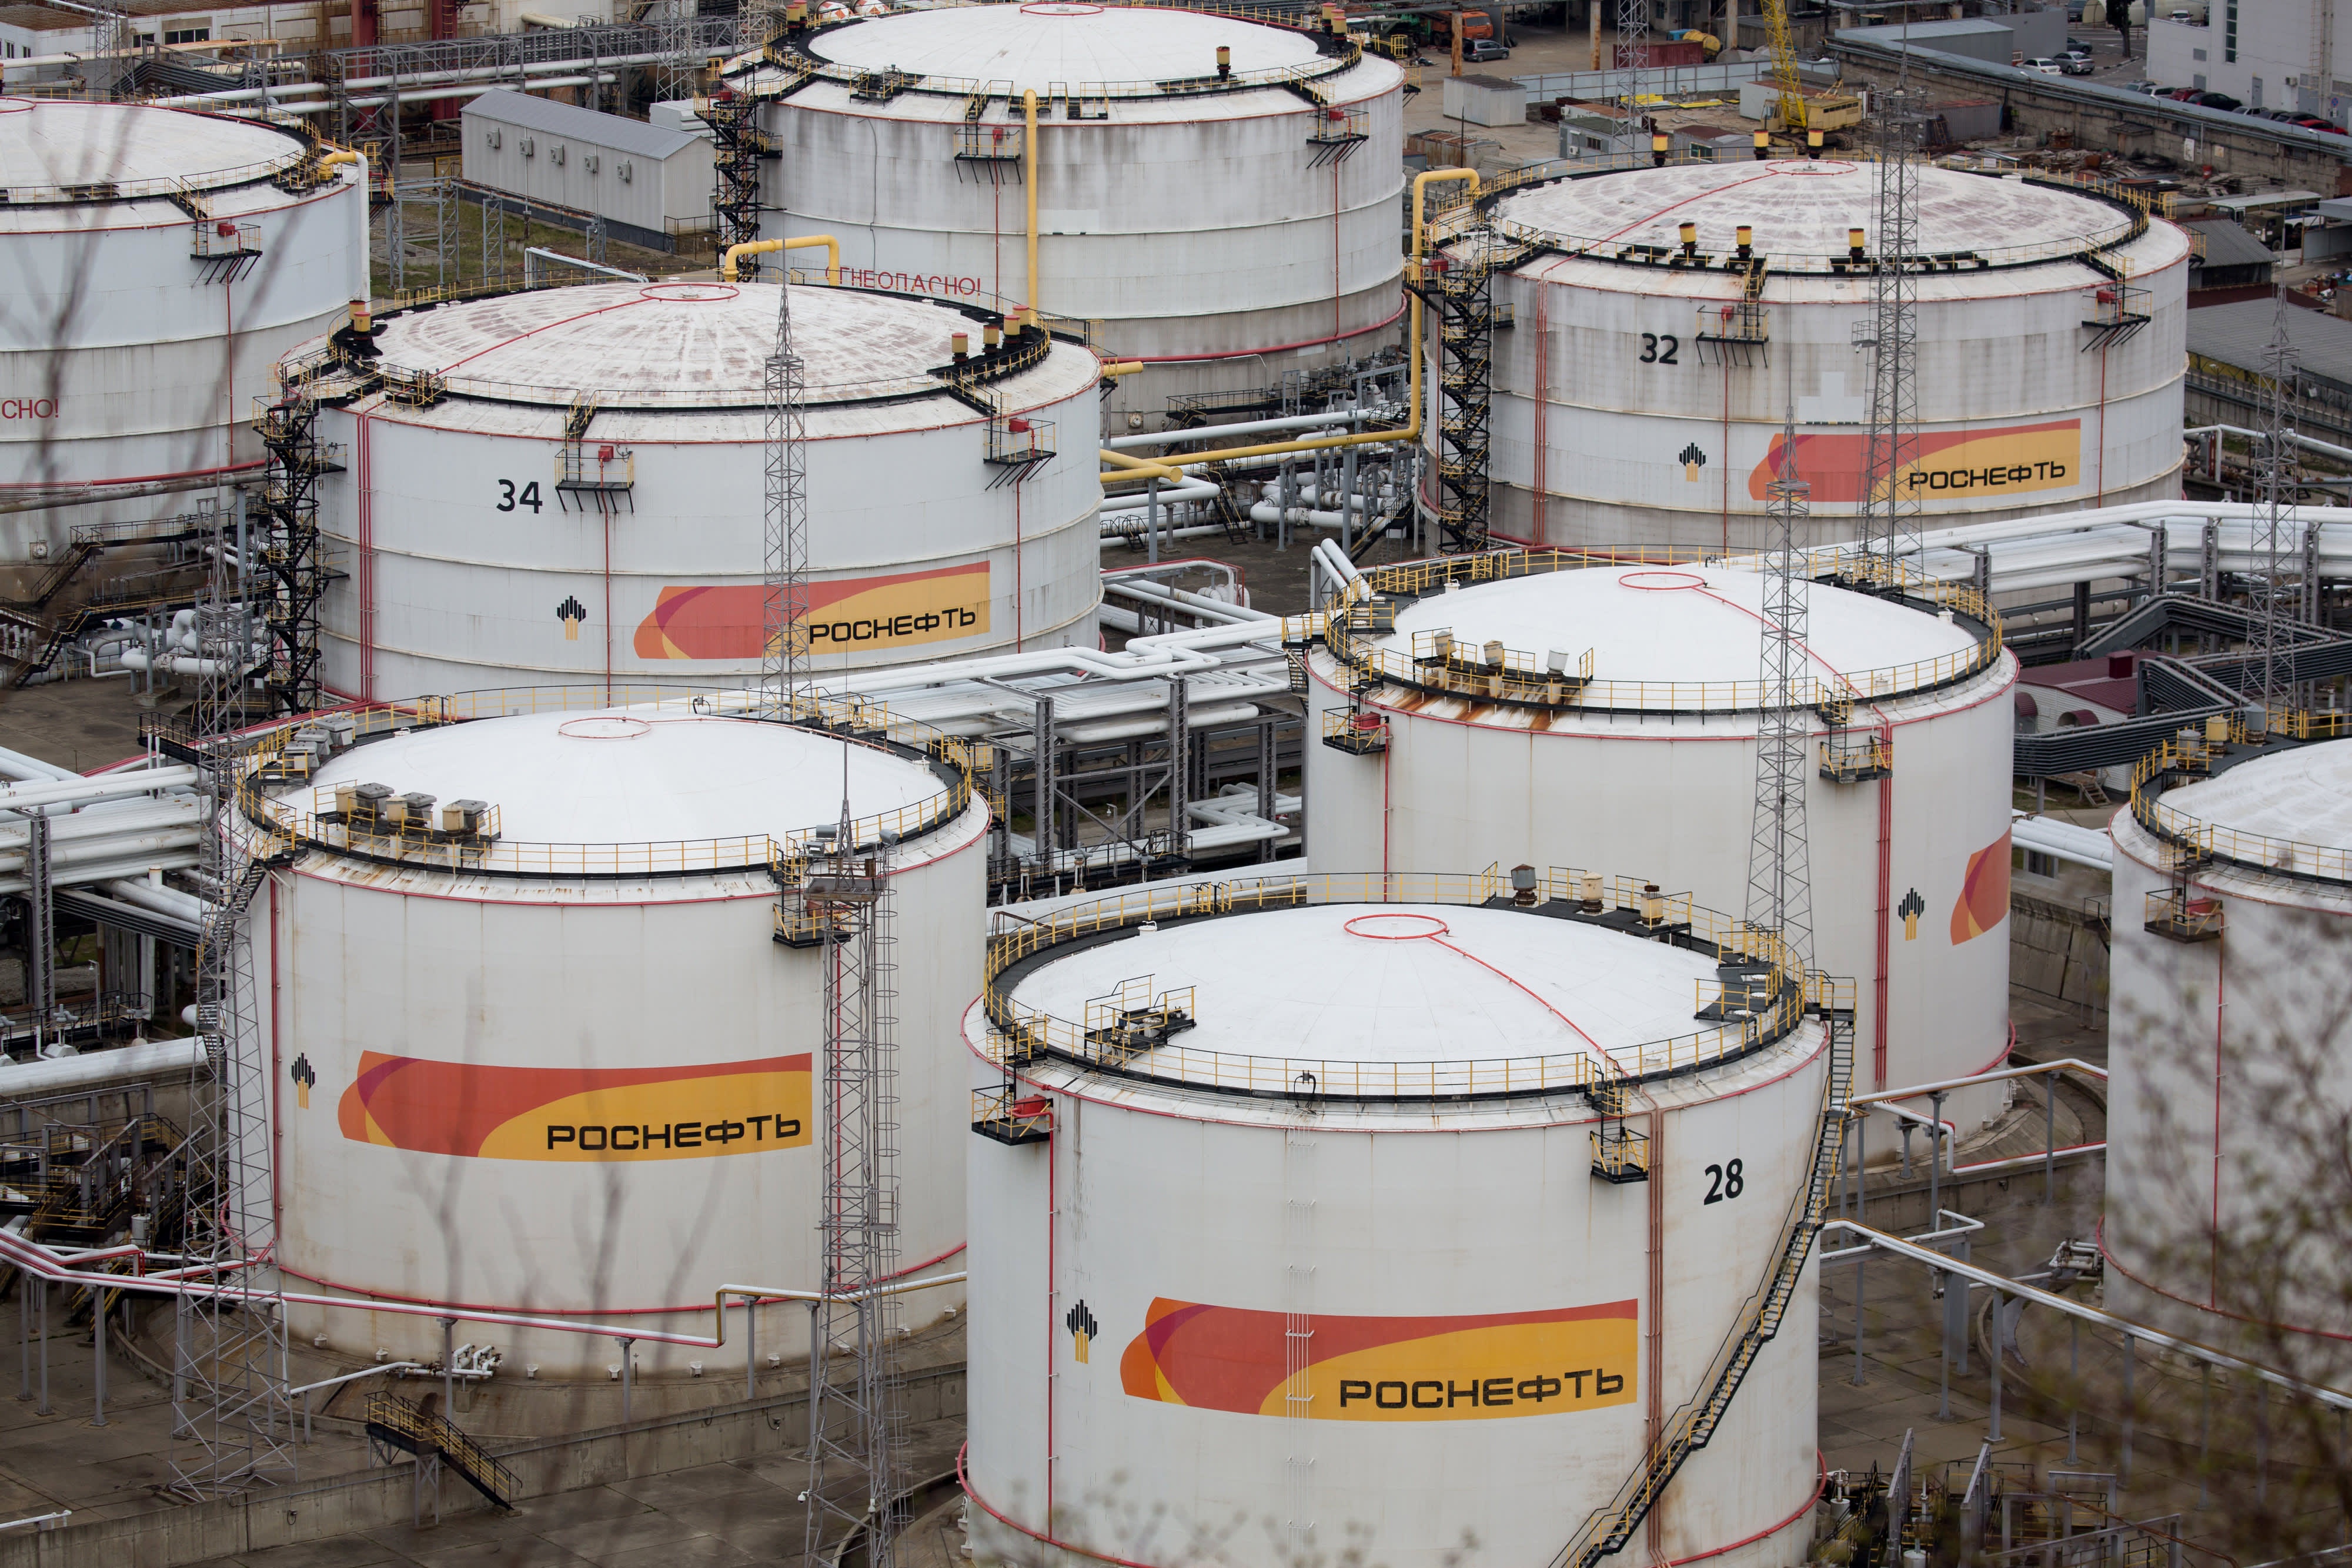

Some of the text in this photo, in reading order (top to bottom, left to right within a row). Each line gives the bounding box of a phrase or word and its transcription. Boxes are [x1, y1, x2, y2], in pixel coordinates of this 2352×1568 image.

[825, 266, 981, 296] ГНЕОПАСНО!
[1639, 333, 1679, 365] 32
[1909, 461, 2066, 490] РОСНЕФТЬ
[496, 479, 543, 514] 34
[809, 607, 976, 644] РОСНЕФТЬ
[547, 1114, 801, 1151] РОСНЕФТЬ
[1703, 1158, 1744, 1205] 28
[1340, 1368, 1624, 1409] РОСНЕФТЬ
